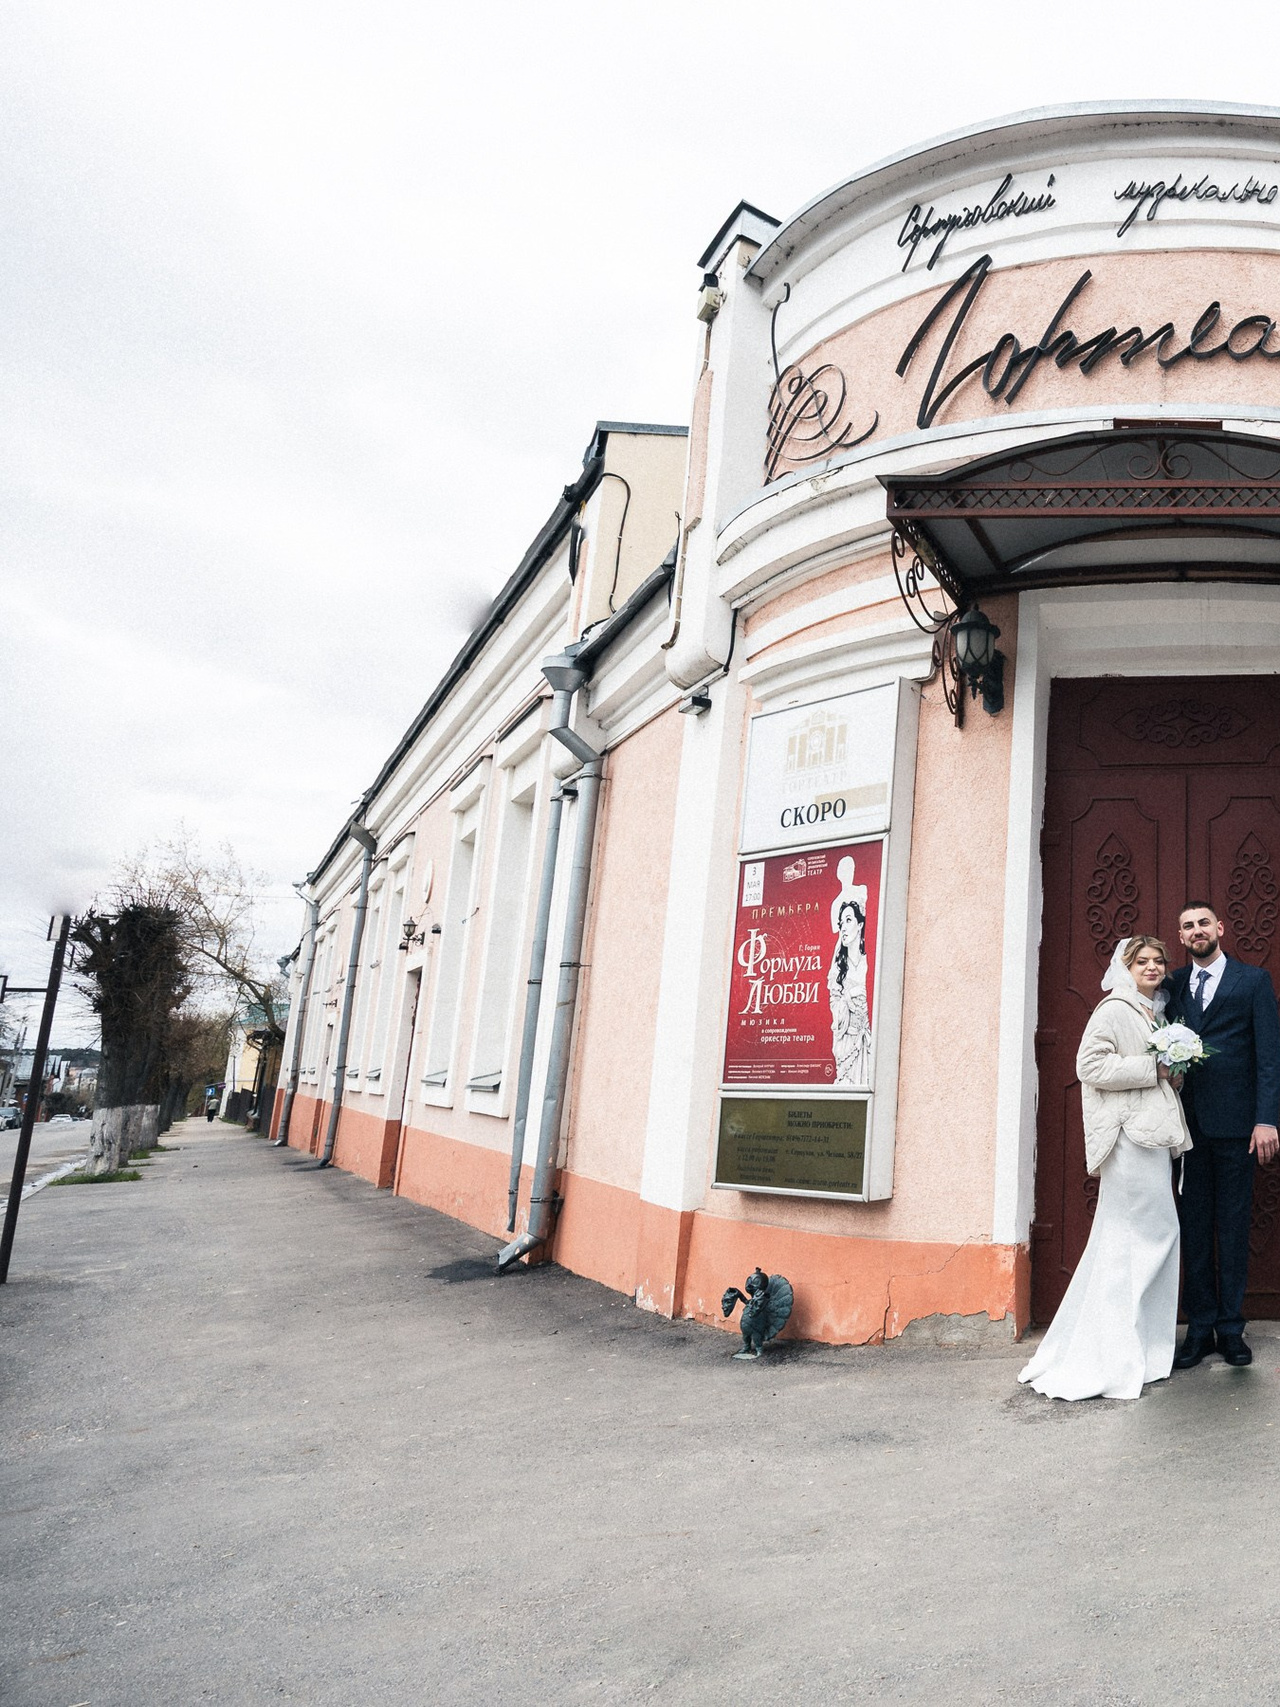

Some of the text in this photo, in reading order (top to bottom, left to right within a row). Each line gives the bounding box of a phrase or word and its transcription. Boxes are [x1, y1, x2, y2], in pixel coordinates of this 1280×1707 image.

[897, 173, 1057, 272] Серпуховский
[780, 798, 846, 828] СКОРО
[752, 866, 757, 876] 3
[747, 880, 760, 889] МАЯ
[752, 902, 820, 920] ПРЕМЬЕРА
[737, 928, 822, 981] Формула
[740, 1018, 785, 1026] МЮЗИКЛ
[760, 1034, 815, 1044] оркестра театра
